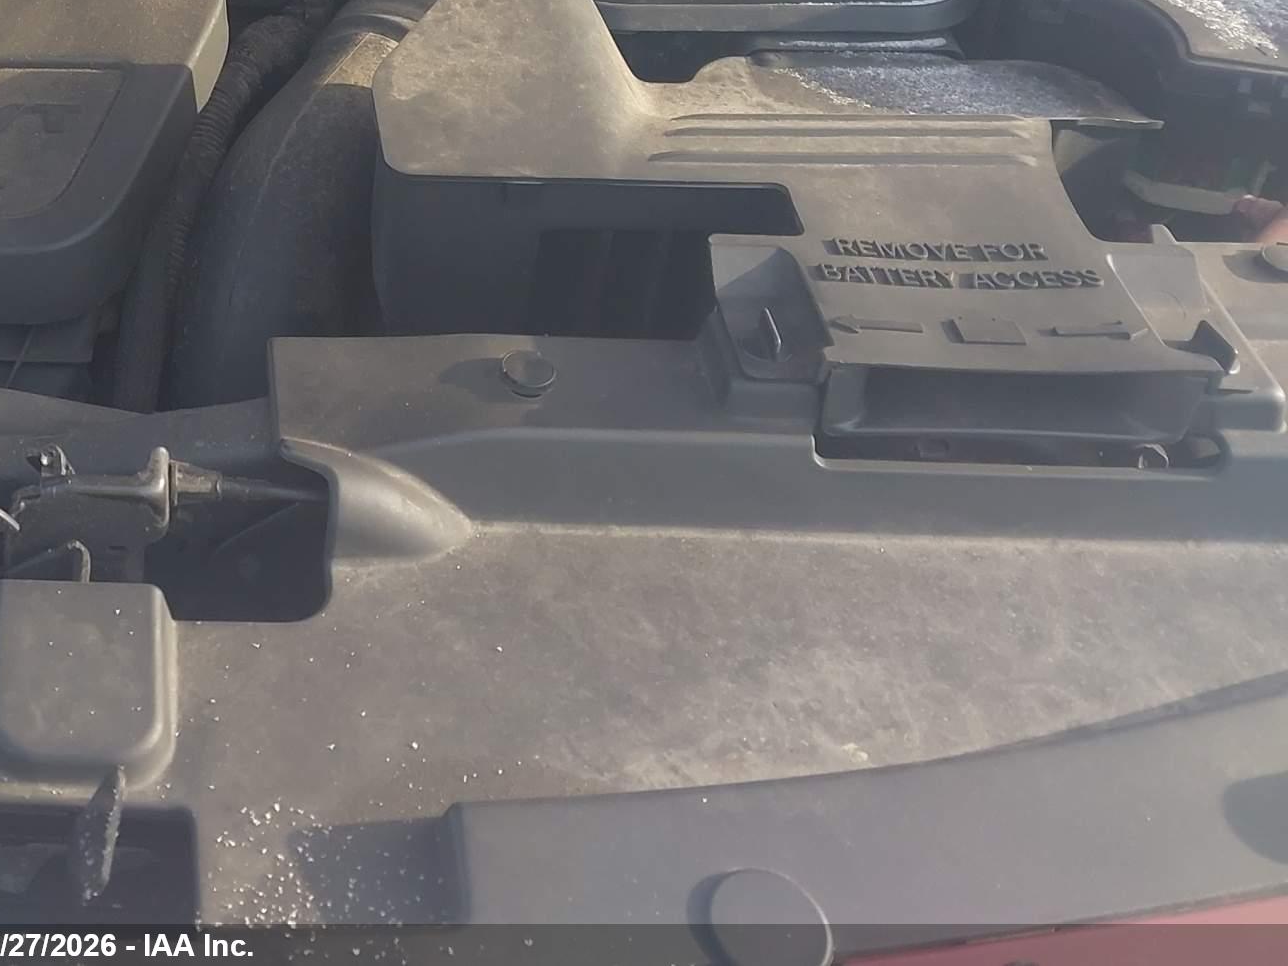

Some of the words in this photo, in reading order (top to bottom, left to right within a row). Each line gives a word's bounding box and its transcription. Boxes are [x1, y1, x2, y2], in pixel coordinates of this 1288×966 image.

[825, 237, 972, 262] REMOVE
[979, 241, 1049, 262] FOR
[810, 263, 955, 289] BATTERY
[962, 267, 1105, 290] ACCESS
